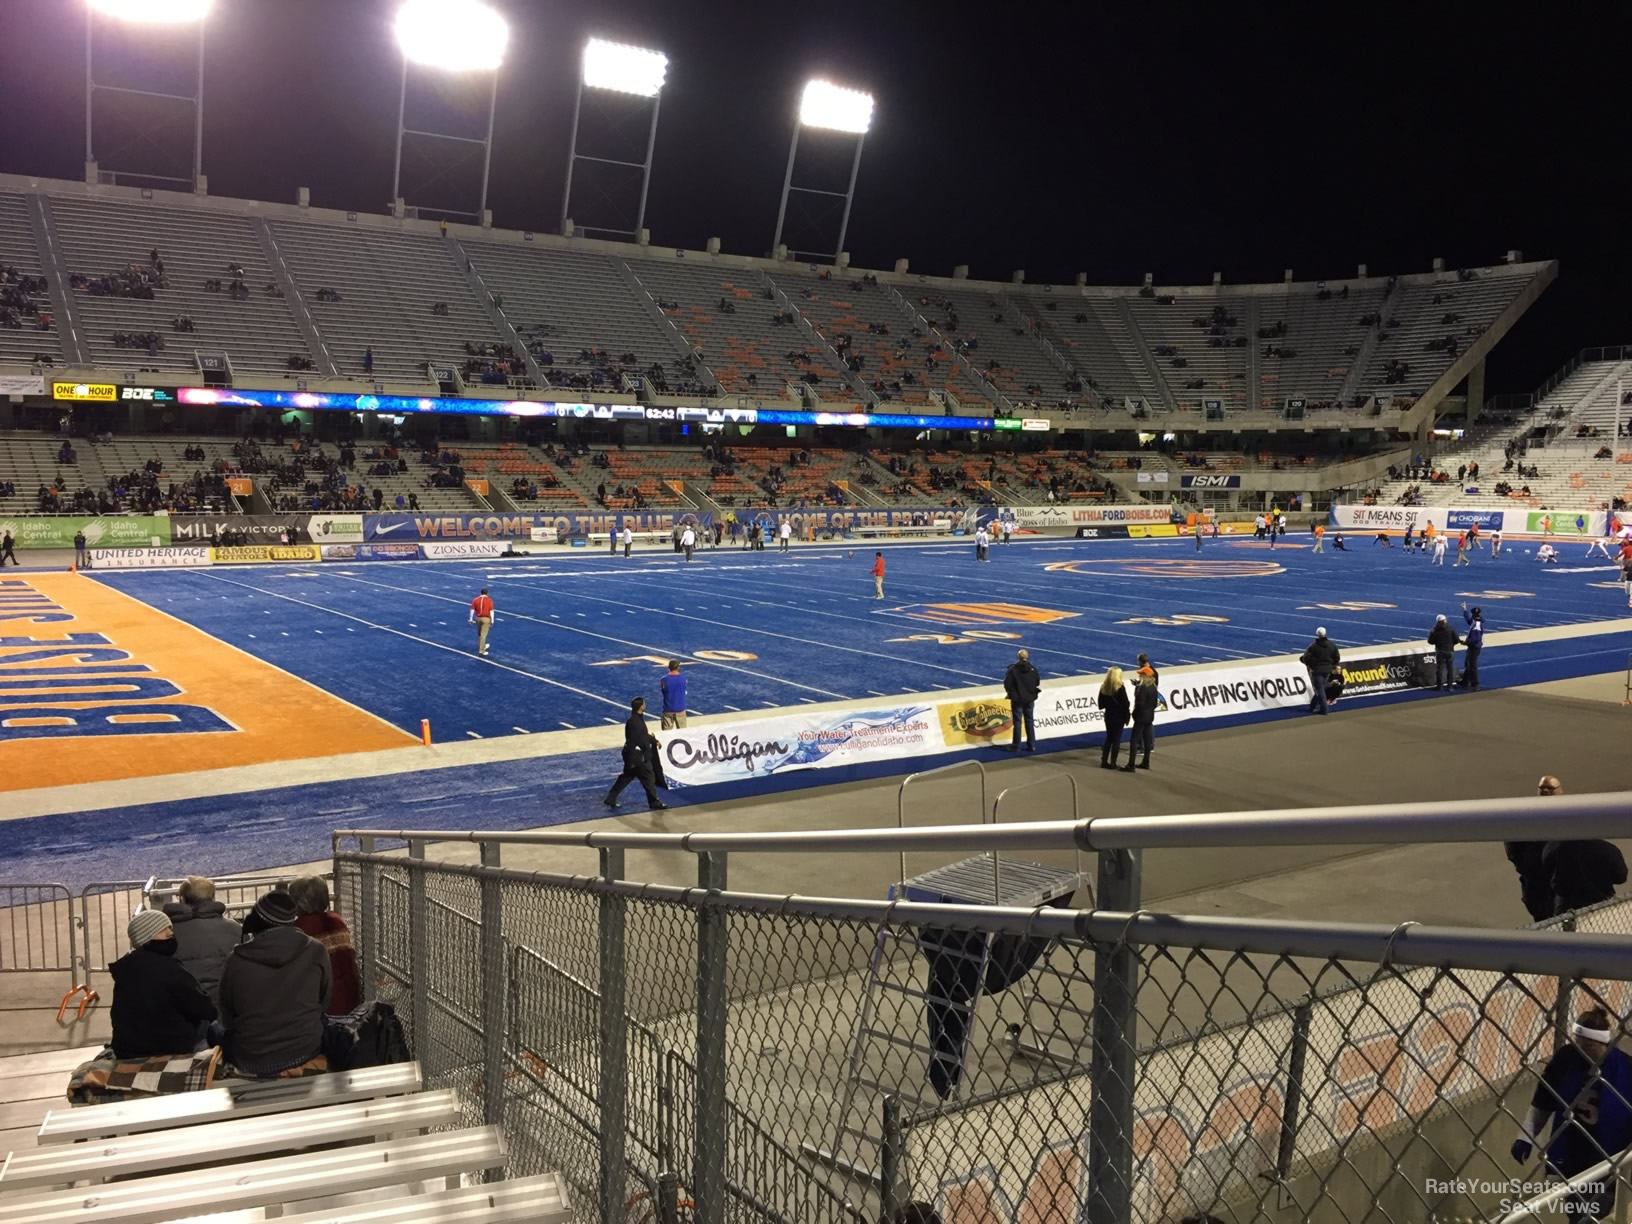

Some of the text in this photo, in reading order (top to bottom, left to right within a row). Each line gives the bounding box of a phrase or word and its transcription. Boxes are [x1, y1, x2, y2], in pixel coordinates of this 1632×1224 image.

[204, 359, 218, 367] 121
[56, 385, 114, 397] ONE HOUR
[122, 388, 155, 401] BOE
[233, 483, 243, 491] 21
[1190, 476, 1230, 487] ISMI
[1016, 509, 1035, 518] Blue
[1072, 508, 1171, 522] LITHIAFORDBOISE.COM
[1353, 510, 1419, 522] SIT MEANS SIT
[1458, 514, 1491, 524] CHOBANI
[831, 512, 854, 528] OF
[857, 511, 888, 528] THE
[1038, 518, 1047, 527] of
[1047, 517, 1068, 527] Idaho
[23, 521, 51, 530] Idaho
[110, 521, 138, 530] Idaho
[176, 523, 228, 538] MILK
[415, 516, 534, 537] WELCOME
[540, 516, 571, 535] TO
[576, 516, 617, 534] THE
[623, 515, 673, 533] BLUE
[23, 531, 62, 540] Central
[111, 530, 148, 538] Central
[96, 546, 206, 560] UNITED HERITAGE
[215, 546, 268, 555] FAMOUS
[272, 551, 314, 560] IDAHO
[433, 545, 499, 555] ZIONS BANK
[215, 552, 268, 561] POTATOES
[107, 557, 198, 568] INSURANCE
[884, 629, 1022, 644] 20
[1170, 676, 1308, 710] CAMPING WORLD
[1055, 696, 1098, 712] A PIZZA
[1033, 713, 1079, 729] CHANGING
[798, 720, 929, 743] Your Water Treatment Experts
[818, 732, 924, 754] www.culliganofidaho.com
[666, 733, 789, 773] Culligan
